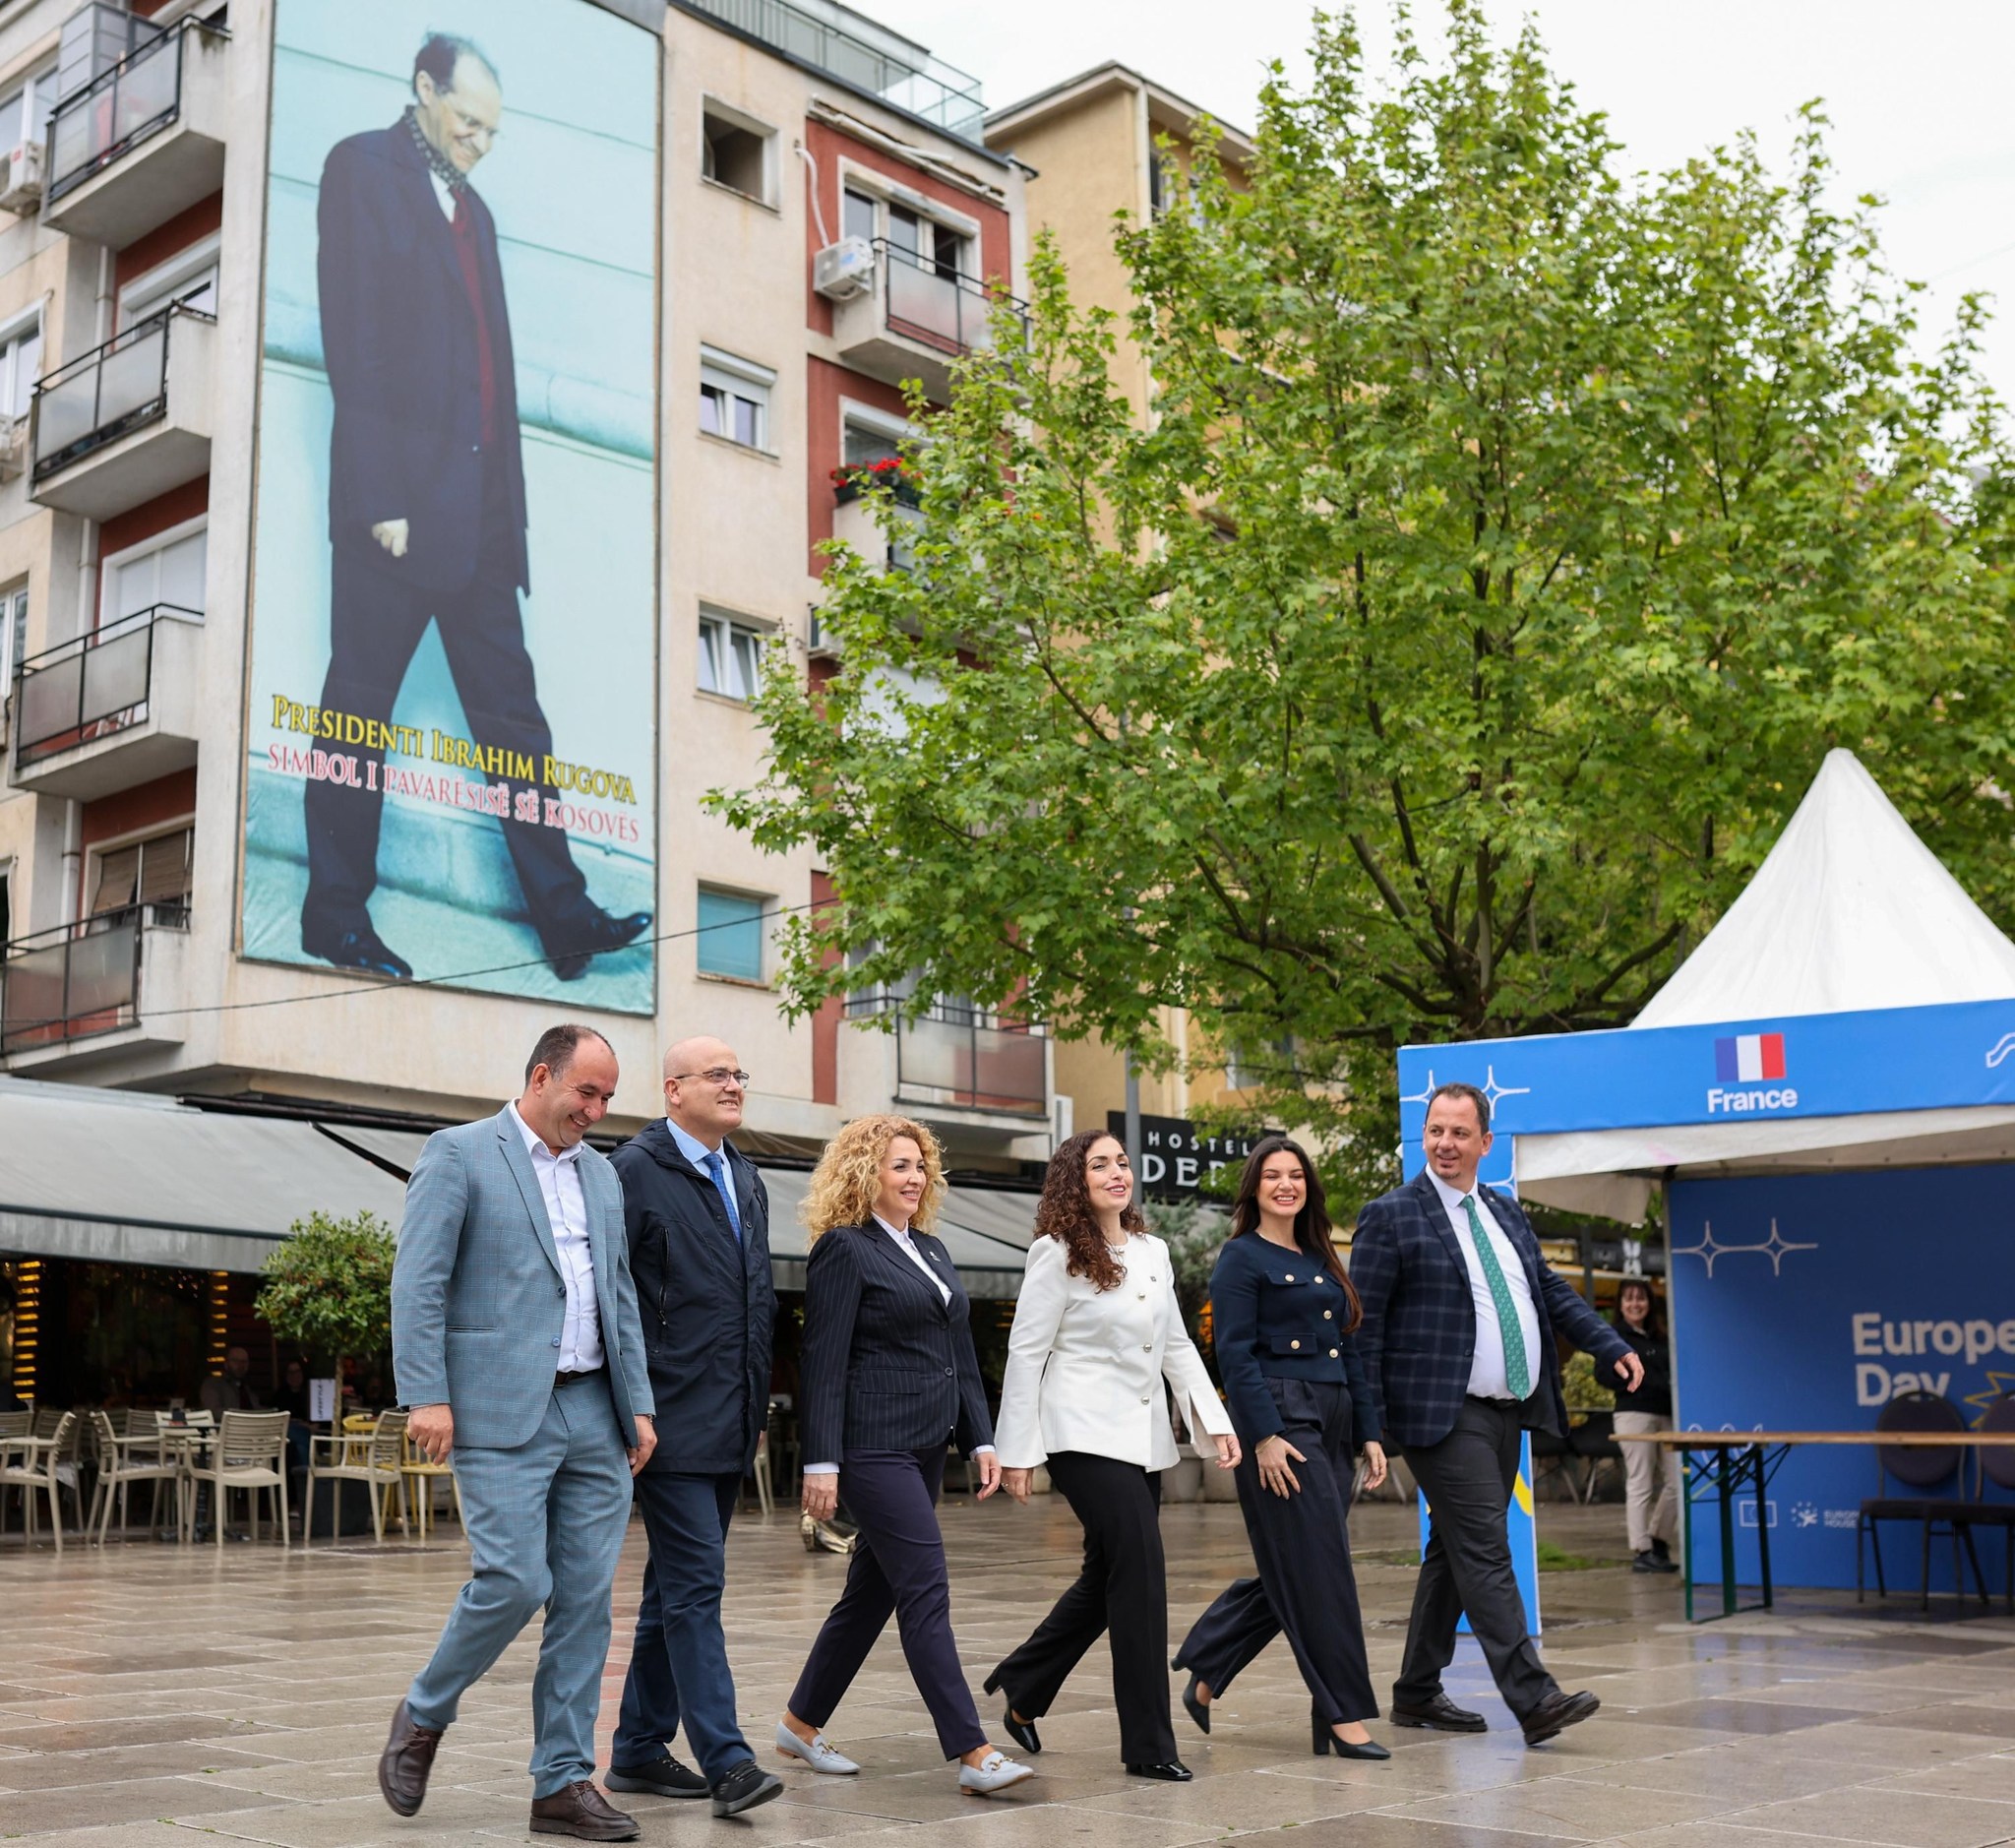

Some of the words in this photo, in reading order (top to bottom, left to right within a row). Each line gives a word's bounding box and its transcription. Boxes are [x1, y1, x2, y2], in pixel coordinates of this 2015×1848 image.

[273, 695, 424, 758] PRESIDENTI
[432, 729, 535, 782] IBRAHIM
[543, 755, 637, 804] RUGOVA
[269, 744, 362, 788] SIMBOL
[366, 761, 378, 790] I
[383, 765, 510, 818] PAVARËSISË
[515, 789, 539, 825] SË
[543, 798, 640, 842] KOSOVËS
[1707, 1088, 1799, 1113] France
[1148, 1132, 1252, 1156] HOSTEL
[1852, 1313, 2015, 1365] Europe
